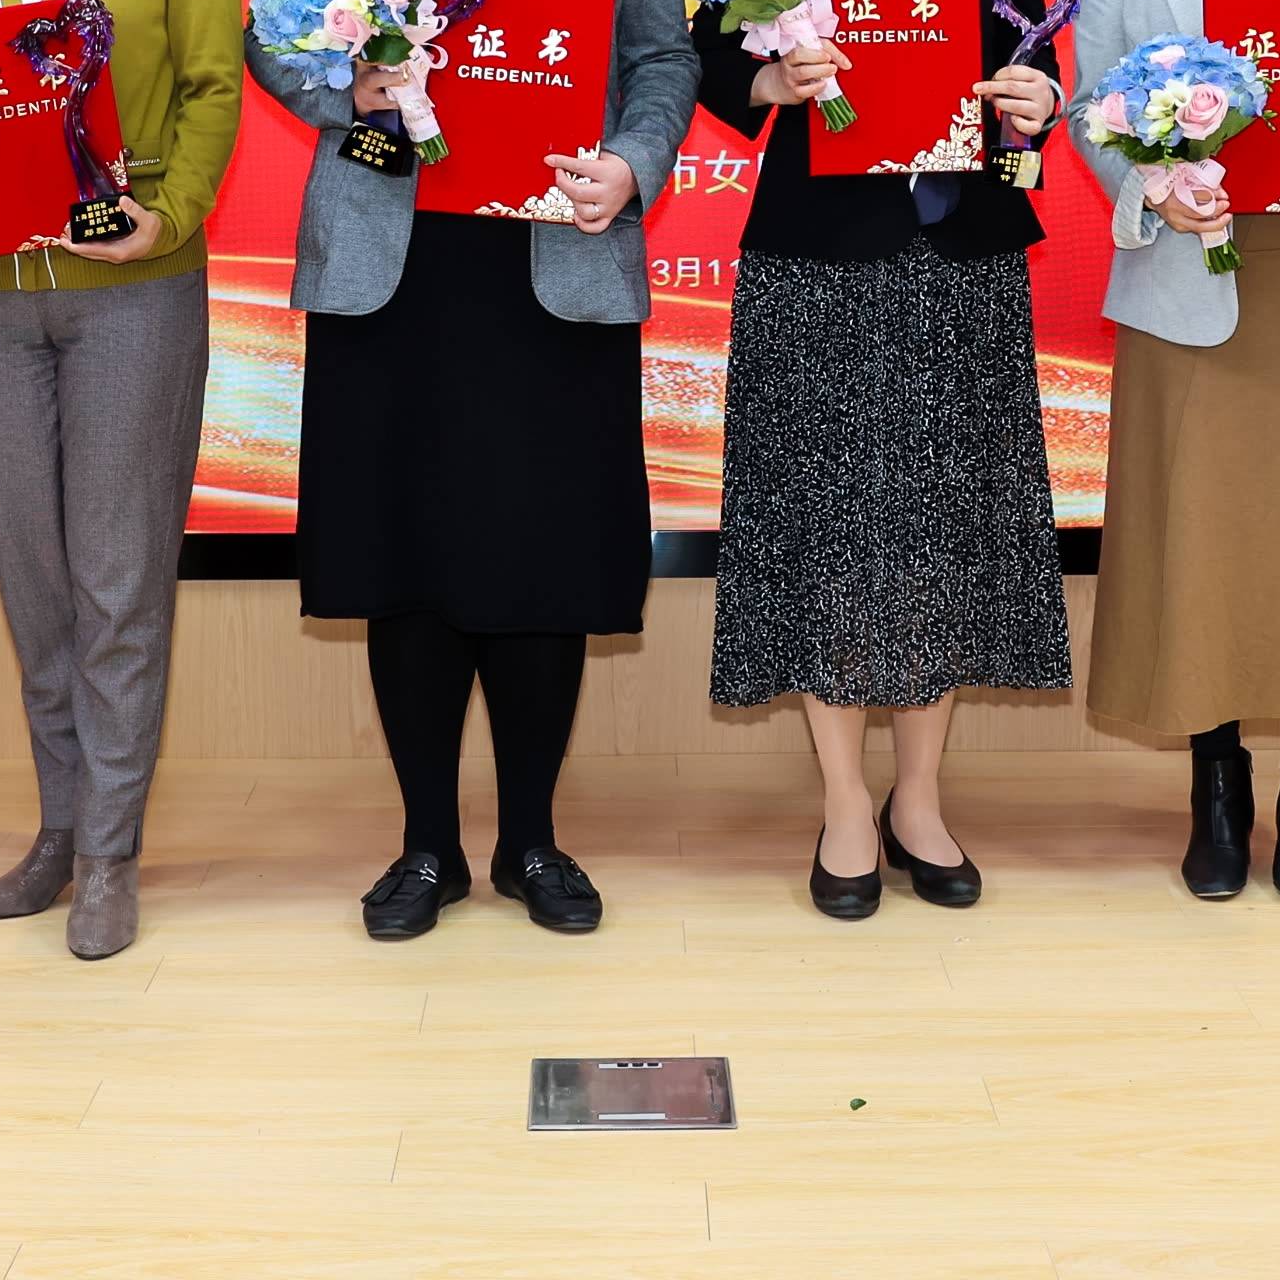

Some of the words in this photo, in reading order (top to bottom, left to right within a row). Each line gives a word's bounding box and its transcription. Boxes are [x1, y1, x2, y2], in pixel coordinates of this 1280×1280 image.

[467, 24, 570, 66] 证书
[835, 29, 948, 44] CREDENTIAL
[458, 65, 573, 88] CREDENTIAL
[673, 149, 765, 194] 市女
